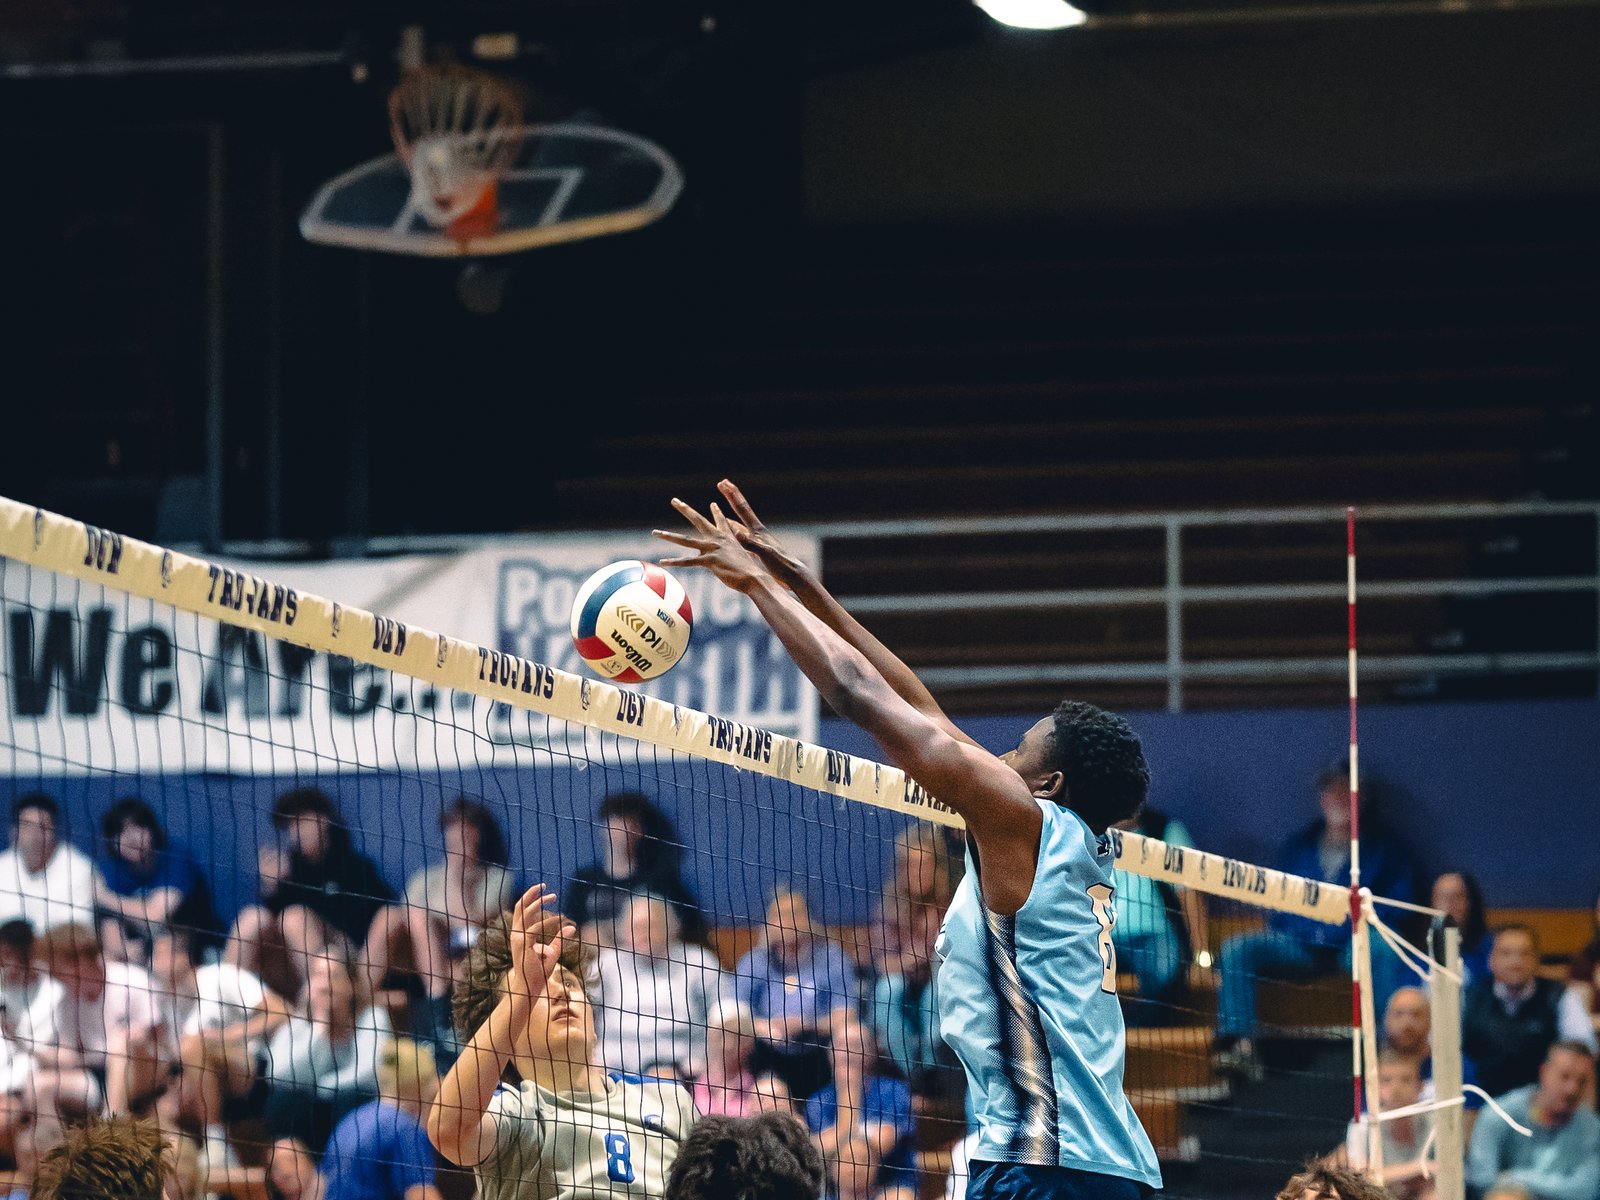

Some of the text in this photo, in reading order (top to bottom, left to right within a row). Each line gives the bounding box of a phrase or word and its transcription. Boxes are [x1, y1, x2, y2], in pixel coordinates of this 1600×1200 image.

[9, 607, 174, 716] We
[610, 629, 653, 673] Wilson
[640, 625, 662, 649] K1
[208, 563, 299, 626] TROJANS
[479, 646, 555, 700] TROJANS
[615, 688, 647, 727] DGN
[708, 716, 772, 764] TROJANS
[604, 1133, 635, 1184] 8
